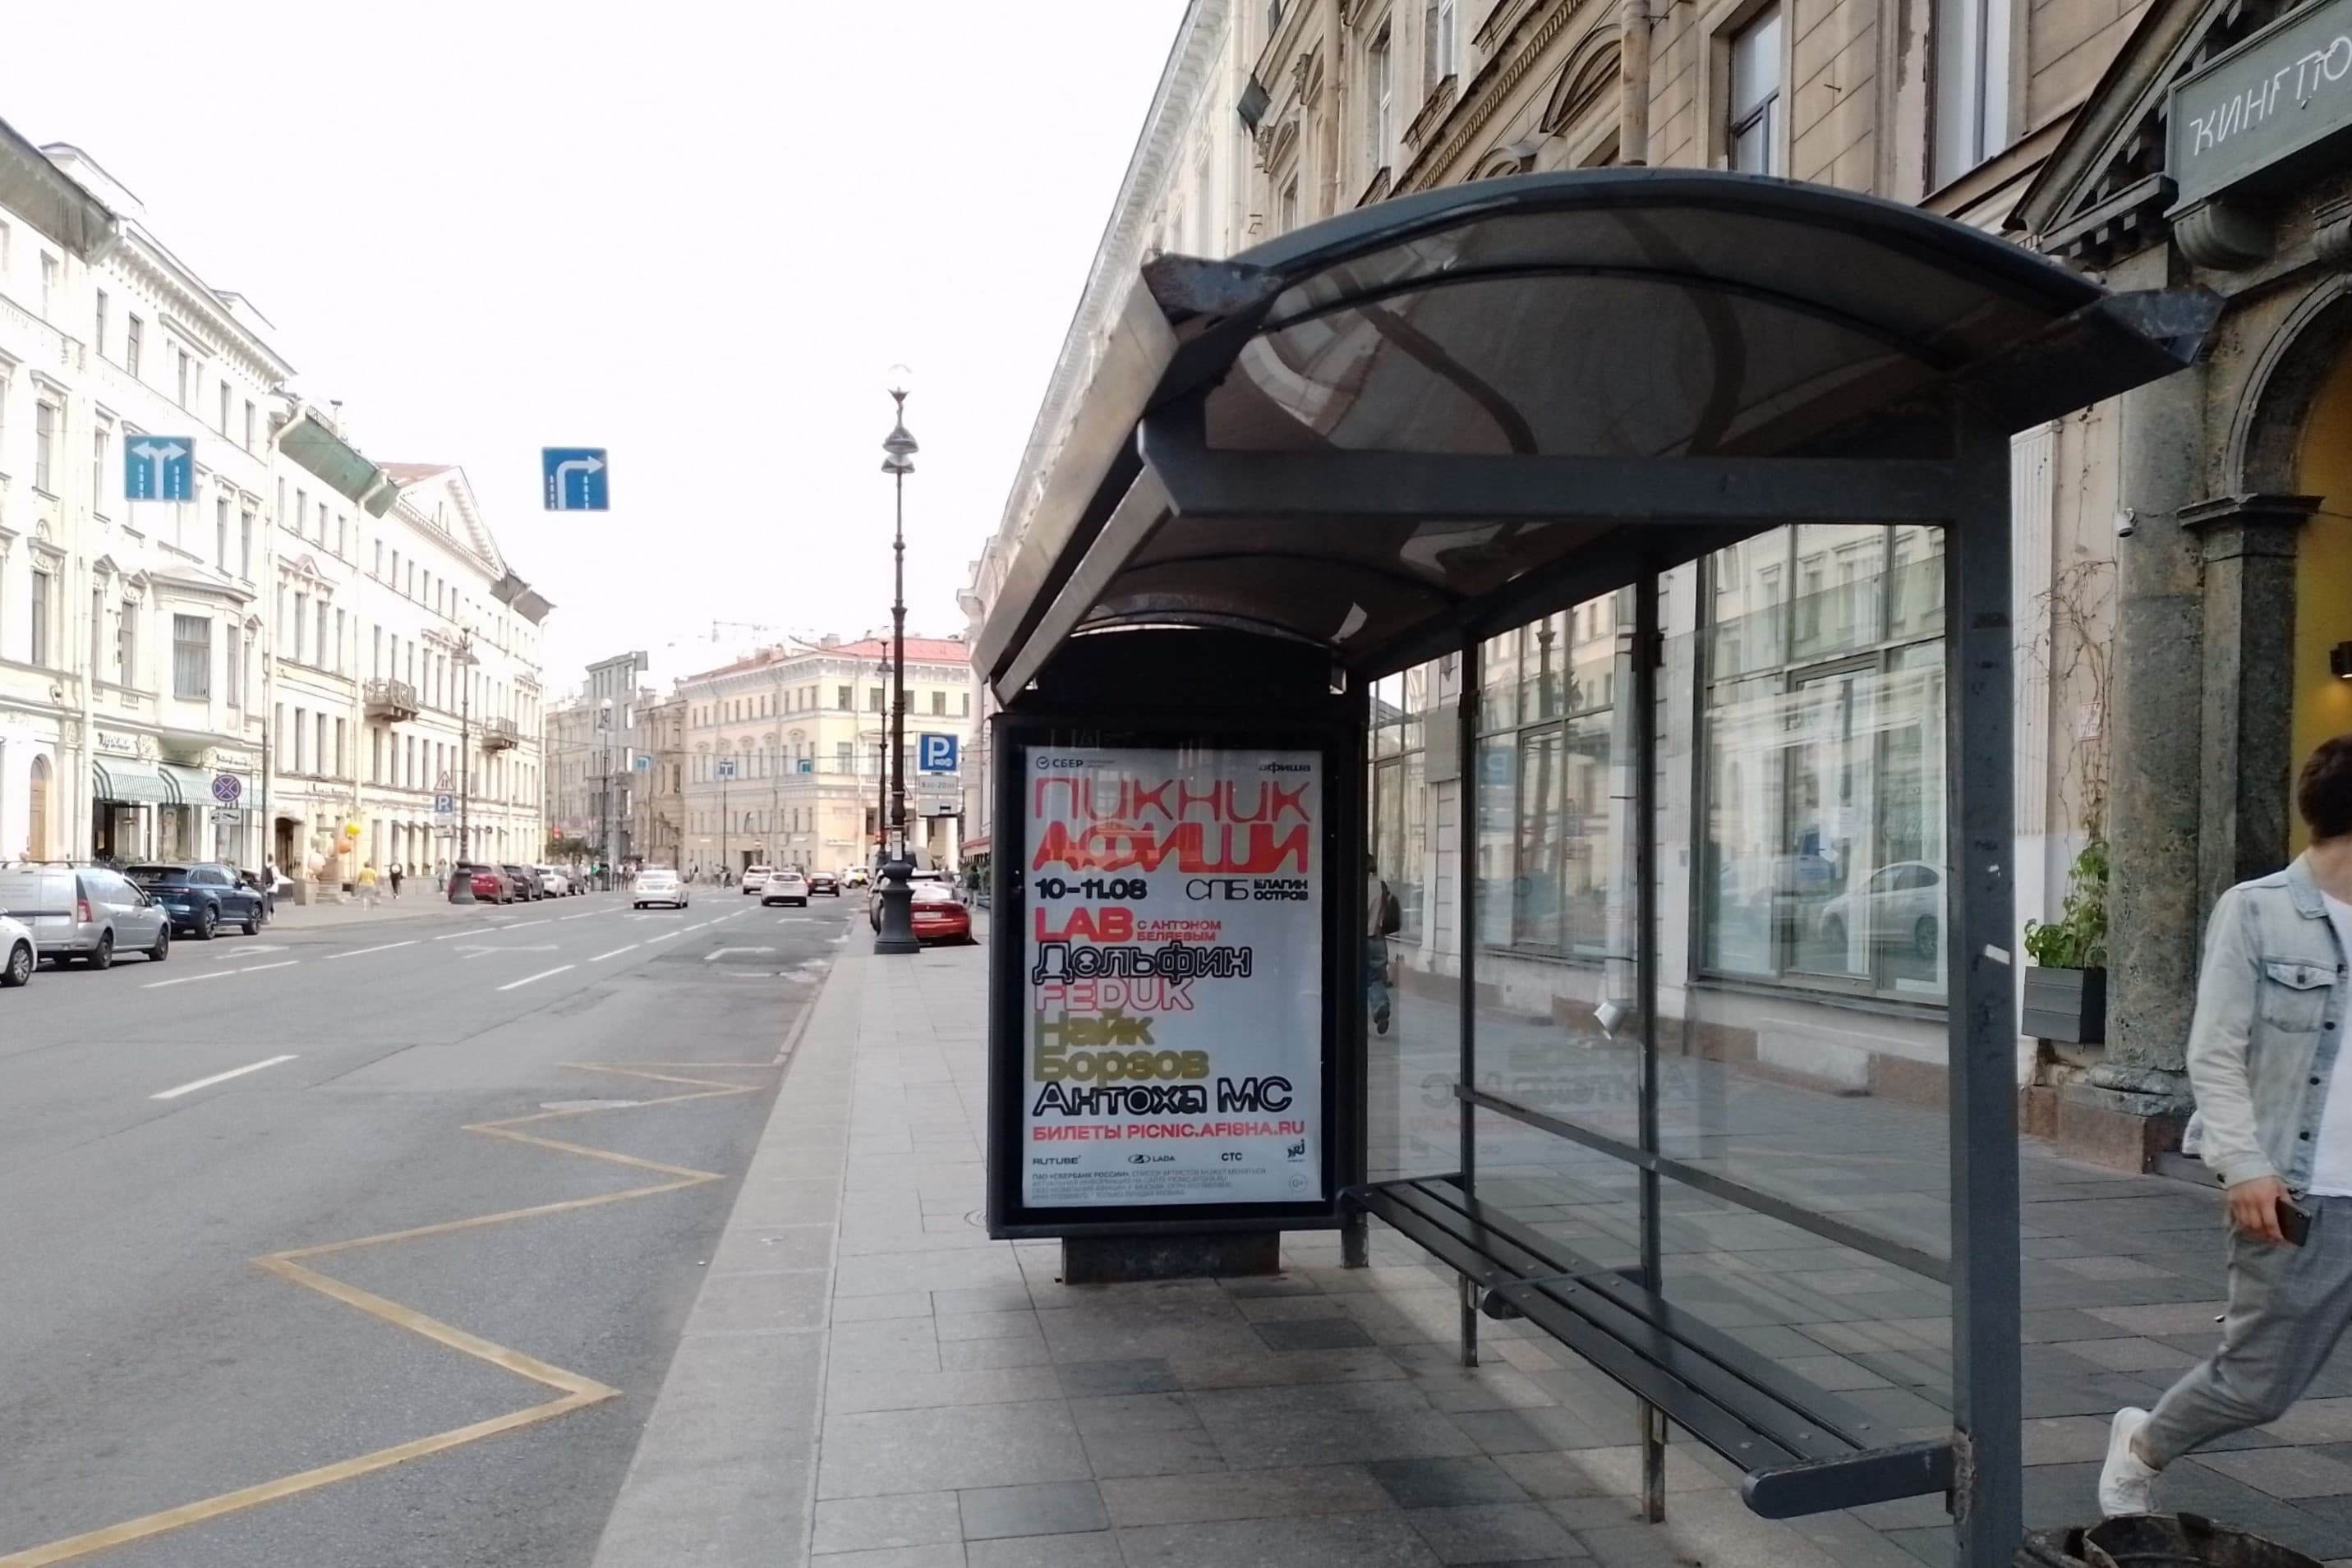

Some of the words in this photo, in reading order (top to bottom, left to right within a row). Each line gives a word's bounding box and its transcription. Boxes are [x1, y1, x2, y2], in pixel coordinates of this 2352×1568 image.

[1052, 758, 1084, 768] СБЕР
[1186, 879, 1250, 901] СПБ
[1254, 879, 1309, 890] ЕЛАГИН
[1254, 890, 1309, 901] ОСТРОВ
[1035, 907, 1135, 942] LAB
[1151, 920, 1222, 931] АНТОНОМ
[1137, 931, 1216, 942] БЕЛЯЕВЫМ
[1033, 977, 1194, 1011] FEDUK
[1033, 1007, 1155, 1047] Найк
[1033, 1048, 1210, 1088] Борзов
[1033, 1081, 1208, 1117] Антоха
[1033, 1124, 1122, 1142] БИЛЕТЫ
[1128, 1120, 1305, 1139] PICNIC.AFISHA.RU
[1033, 1156, 1079, 1166] RUTUBE
[1152, 1155, 1176, 1163] LADA
